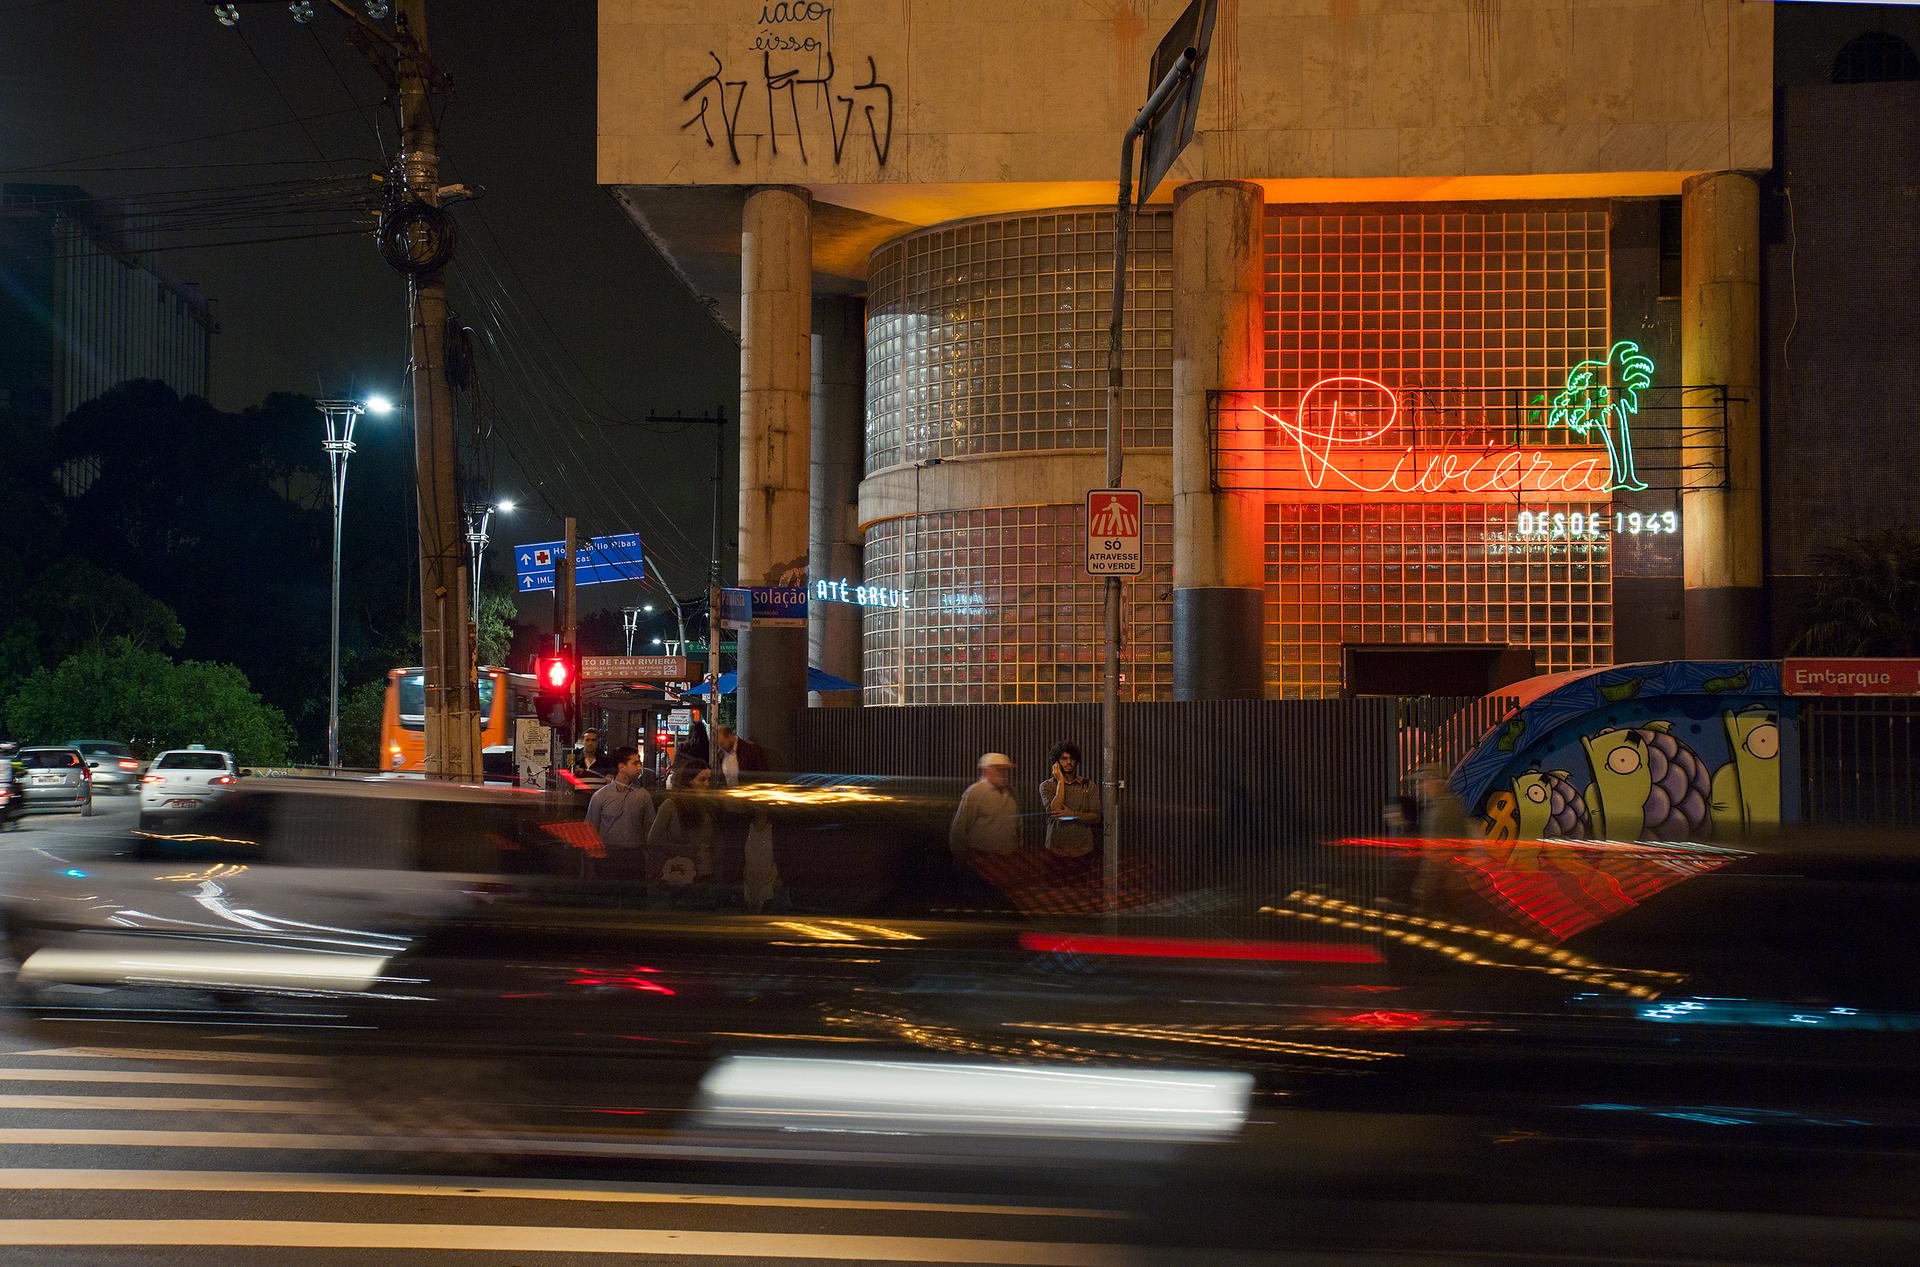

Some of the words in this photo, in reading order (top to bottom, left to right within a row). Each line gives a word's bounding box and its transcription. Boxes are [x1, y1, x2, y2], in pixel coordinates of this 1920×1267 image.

[1253, 376, 1612, 492] Riviera
[1517, 512, 1600, 535] DESDE
[1616, 511, 1677, 534] 1949
[1104, 538, 1122, 550] SÓ
[1089, 553, 1139, 561] ATRAVESSE
[1092, 562, 1105, 570] NO
[1107, 562, 1136, 570] VERDE
[536, 576, 553, 585] IML
[817, 577, 850, 603] ATÉ
[856, 586, 911, 609] BREVE
[1795, 669, 1890, 687] Embarque
